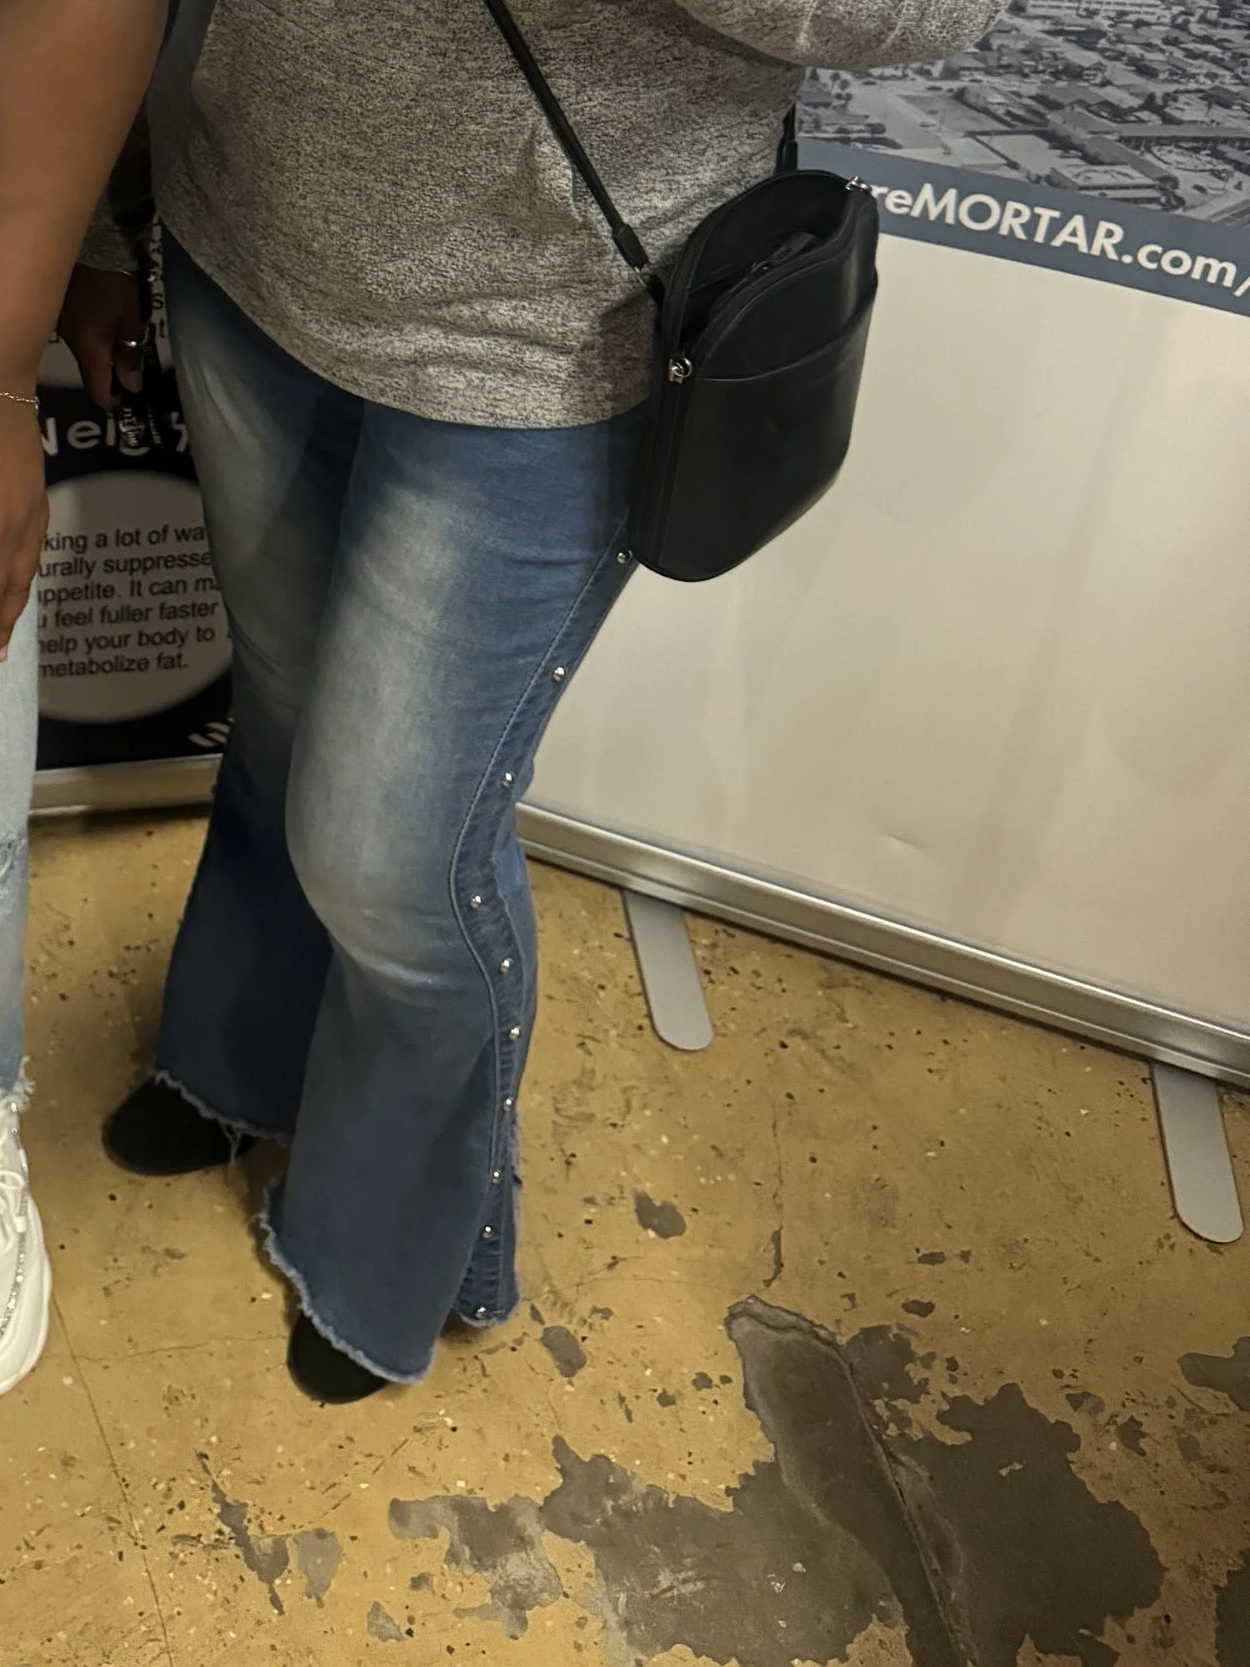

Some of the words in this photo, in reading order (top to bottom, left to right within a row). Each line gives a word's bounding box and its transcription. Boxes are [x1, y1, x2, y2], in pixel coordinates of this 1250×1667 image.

[44, 532, 88, 554] king
[95, 533, 107, 548] a
[115, 528, 141, 547] lot
[148, 525, 168, 545] of
[38, 557, 96, 580] urally
[103, 551, 213, 576] suppresse
[129, 579, 143, 597] It
[149, 578, 187, 596] can
[54, 608, 93, 628] feel
[100, 604, 154, 625] fuller
[159, 600, 219, 621] faster
[85, 632, 132, 654] your
[137, 627, 189, 648] body
[196, 625, 216, 643] to
